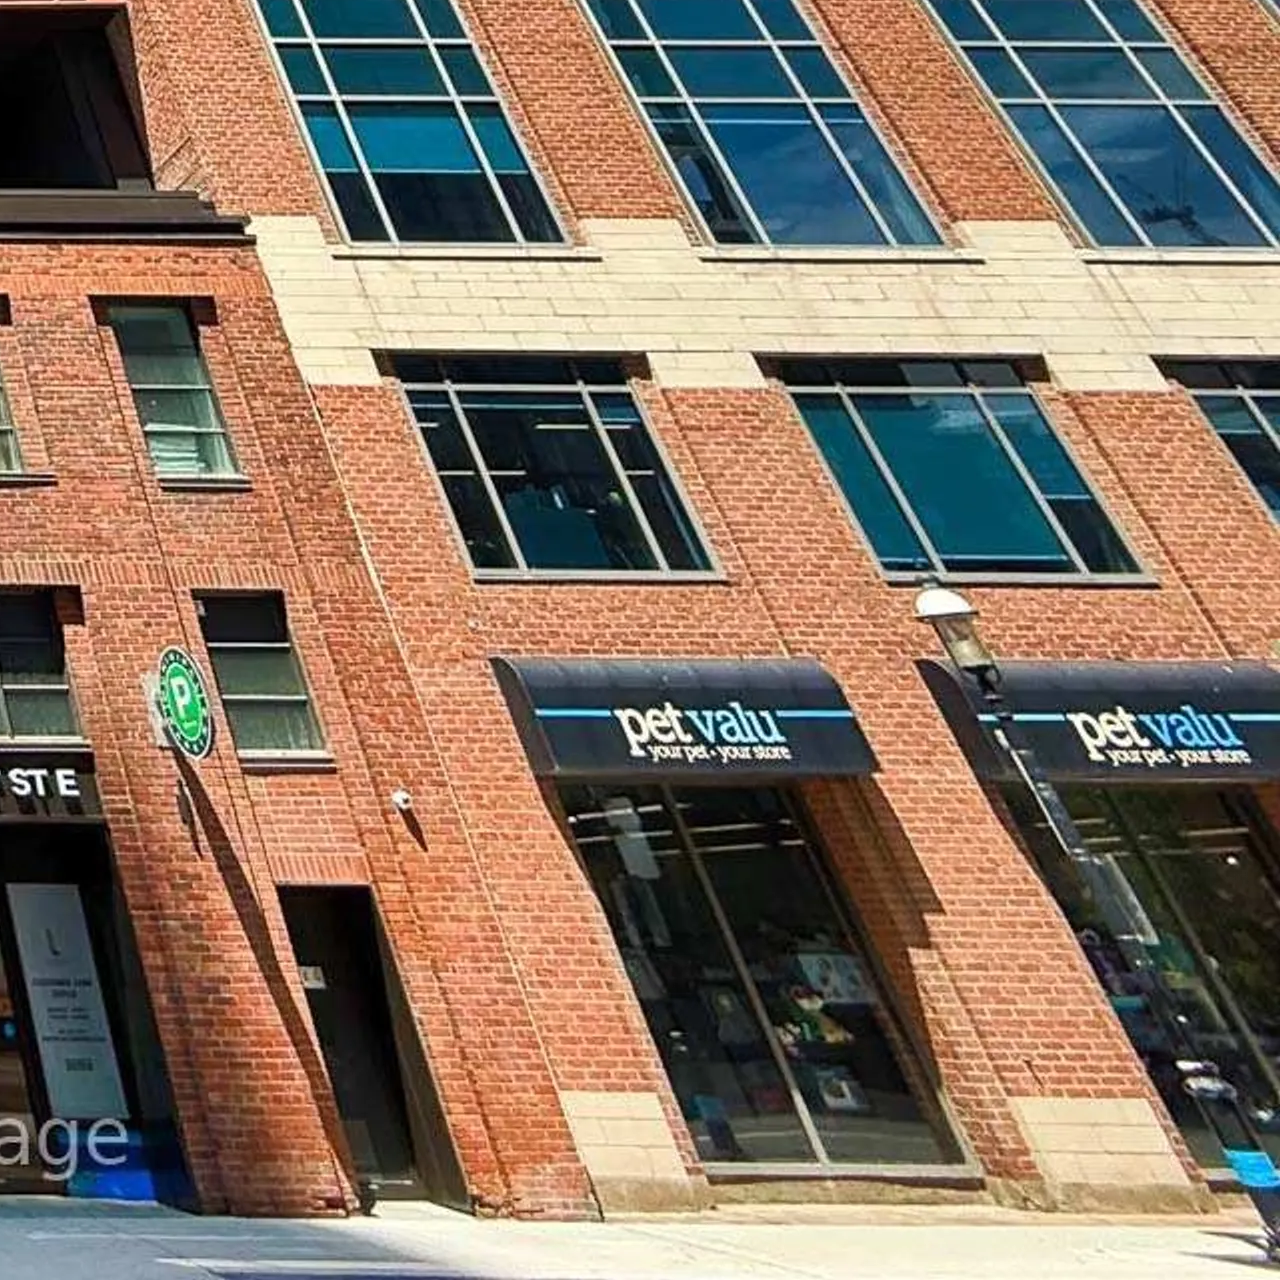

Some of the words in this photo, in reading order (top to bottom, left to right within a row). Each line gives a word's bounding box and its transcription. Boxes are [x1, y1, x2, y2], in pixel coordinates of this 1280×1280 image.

[170, 676, 192, 721] P
[613, 701, 693, 757] pet
[684, 701, 787, 743] valu
[1065, 705, 1151, 761] pet
[1137, 704, 1244, 747] valu
[647, 744, 683, 763] your
[683, 744, 710, 763] pet
[716, 745, 752, 763] your
[752, 745, 792, 759] store
[1105, 749, 1142, 767] your
[1142, 748, 1171, 767] pet
[1175, 749, 1212, 767] your
[1212, 748, 1252, 763] store
[8, 768, 48, 796] ST
[56, 768, 81, 796] E
